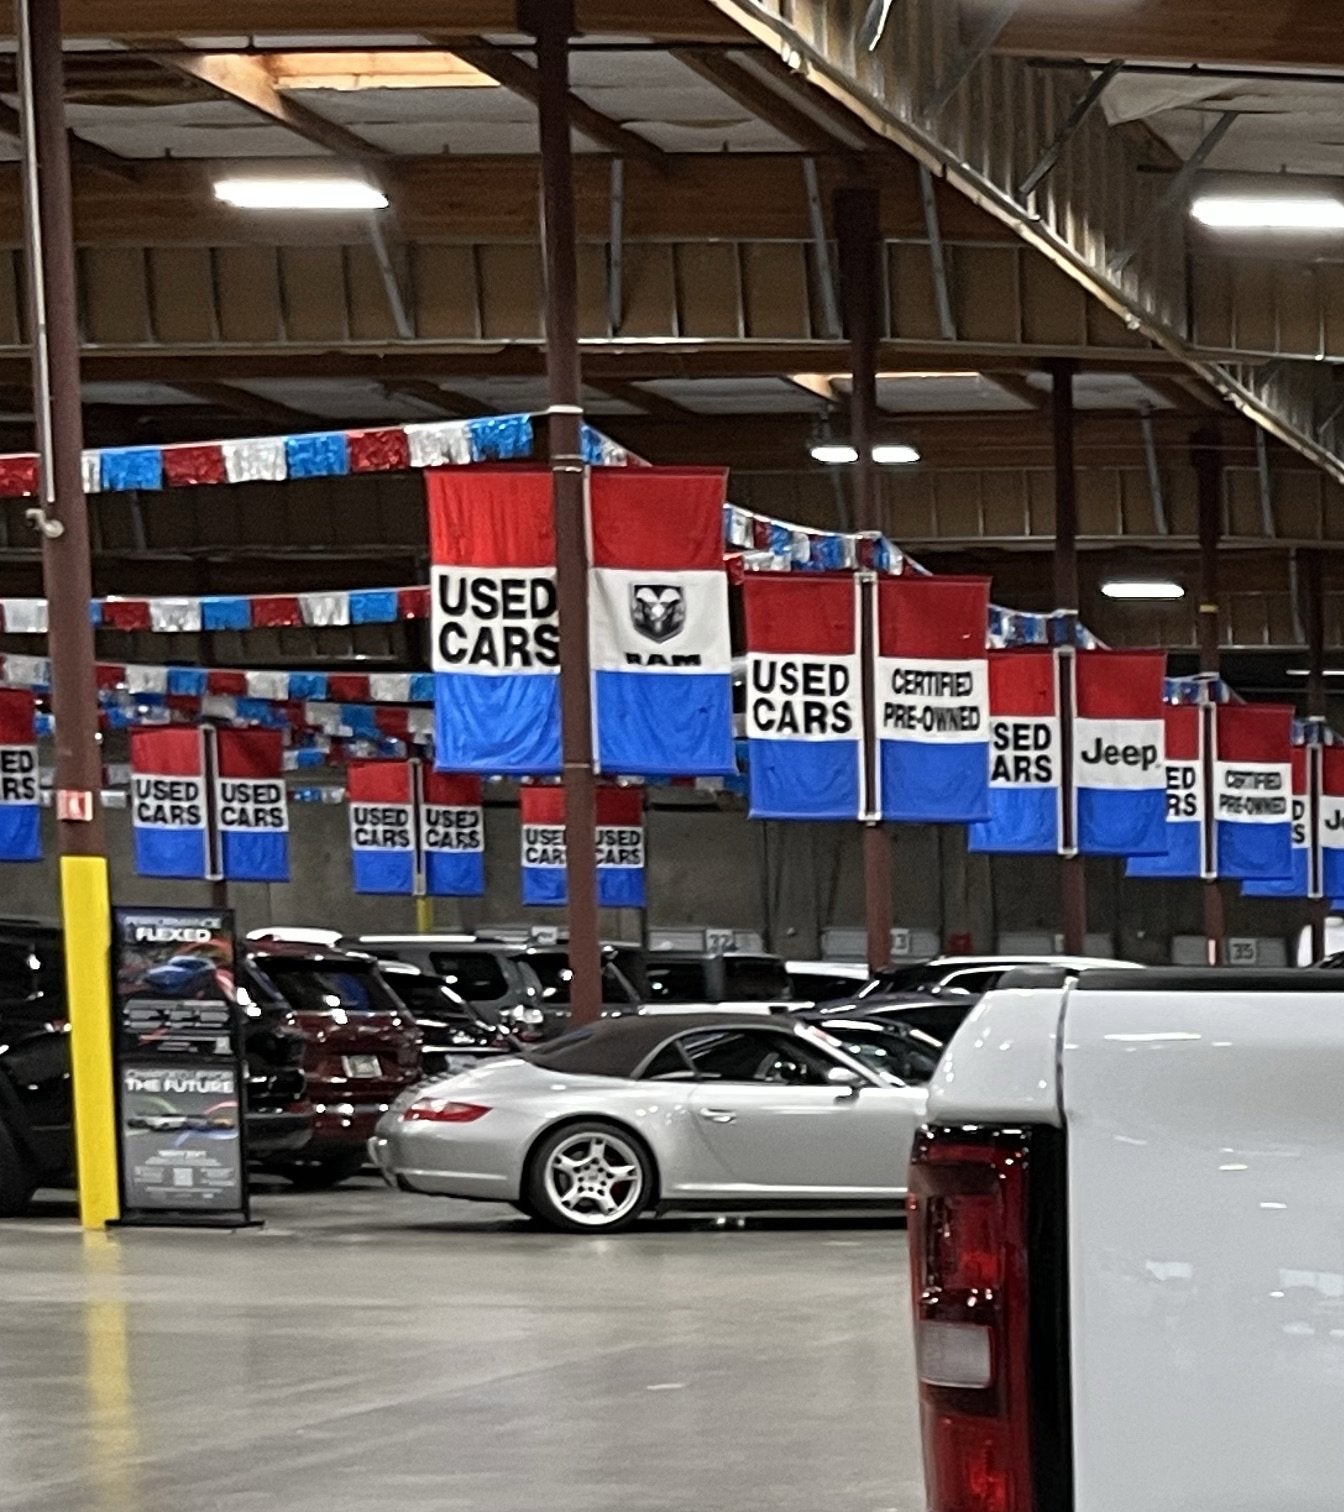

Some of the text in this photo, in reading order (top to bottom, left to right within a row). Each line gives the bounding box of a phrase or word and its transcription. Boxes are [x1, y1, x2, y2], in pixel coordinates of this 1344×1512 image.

[438, 574, 557, 620] USED
[438, 621, 560, 667] CARS
[752, 659, 850, 697] USED
[892, 668, 973, 697] CERTIFIED
[752, 697, 852, 734] CARS
[883, 702, 981, 732] PRE-OWNED
[993, 722, 1051, 751] SED
[0, 750, 34, 773] ED
[1081, 737, 1158, 771] Jeep
[991, 754, 1052, 782] ARS
[1165, 766, 1196, 789] ED
[1, 777, 36, 800] RS
[135, 779, 199, 801] USED
[220, 782, 282, 804] USED
[136, 804, 202, 825] CARS
[1166, 793, 1197, 816] RS
[220, 806, 285, 828] CARS
[353, 806, 409, 827] USED
[425, 808, 479, 829] USED
[354, 828, 410, 849] CARS
[525, 828, 565, 846] USE
[525, 847, 564, 865] CAR
[135, 926, 212, 943] FLEXED
[124, 1078, 234, 1094] THE FUTURE
